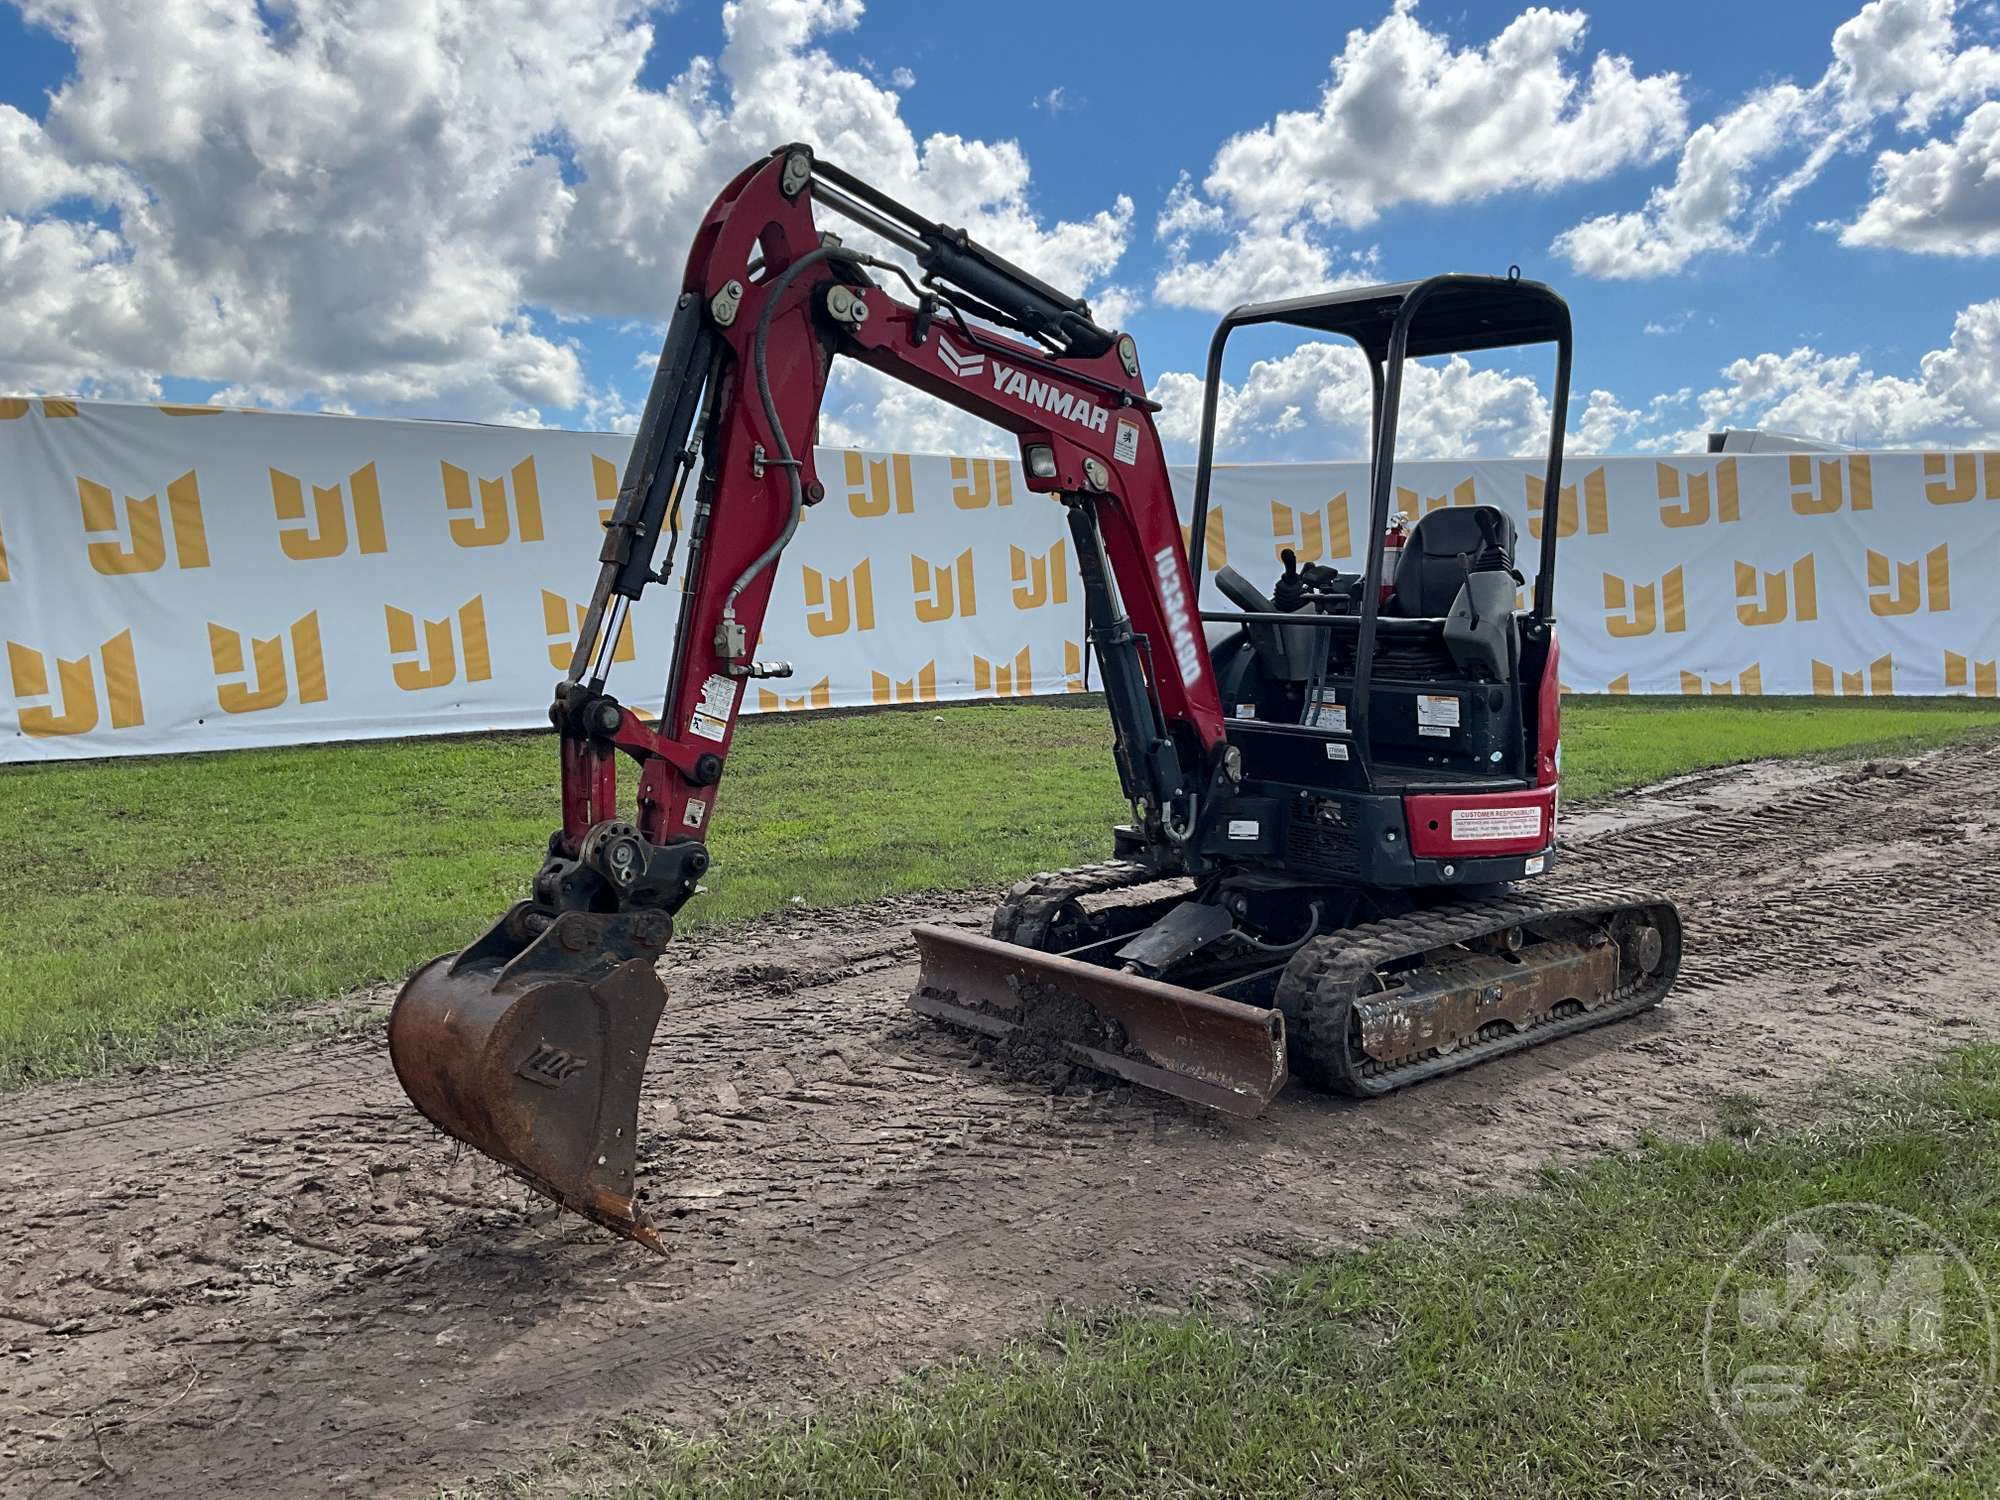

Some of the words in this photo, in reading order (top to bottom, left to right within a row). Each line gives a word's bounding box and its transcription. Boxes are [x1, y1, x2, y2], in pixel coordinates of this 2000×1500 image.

[992, 361, 1109, 434] YANMAR
[1154, 545, 1201, 688] 10334490
[1460, 811, 1494, 819] CUSTOMER
